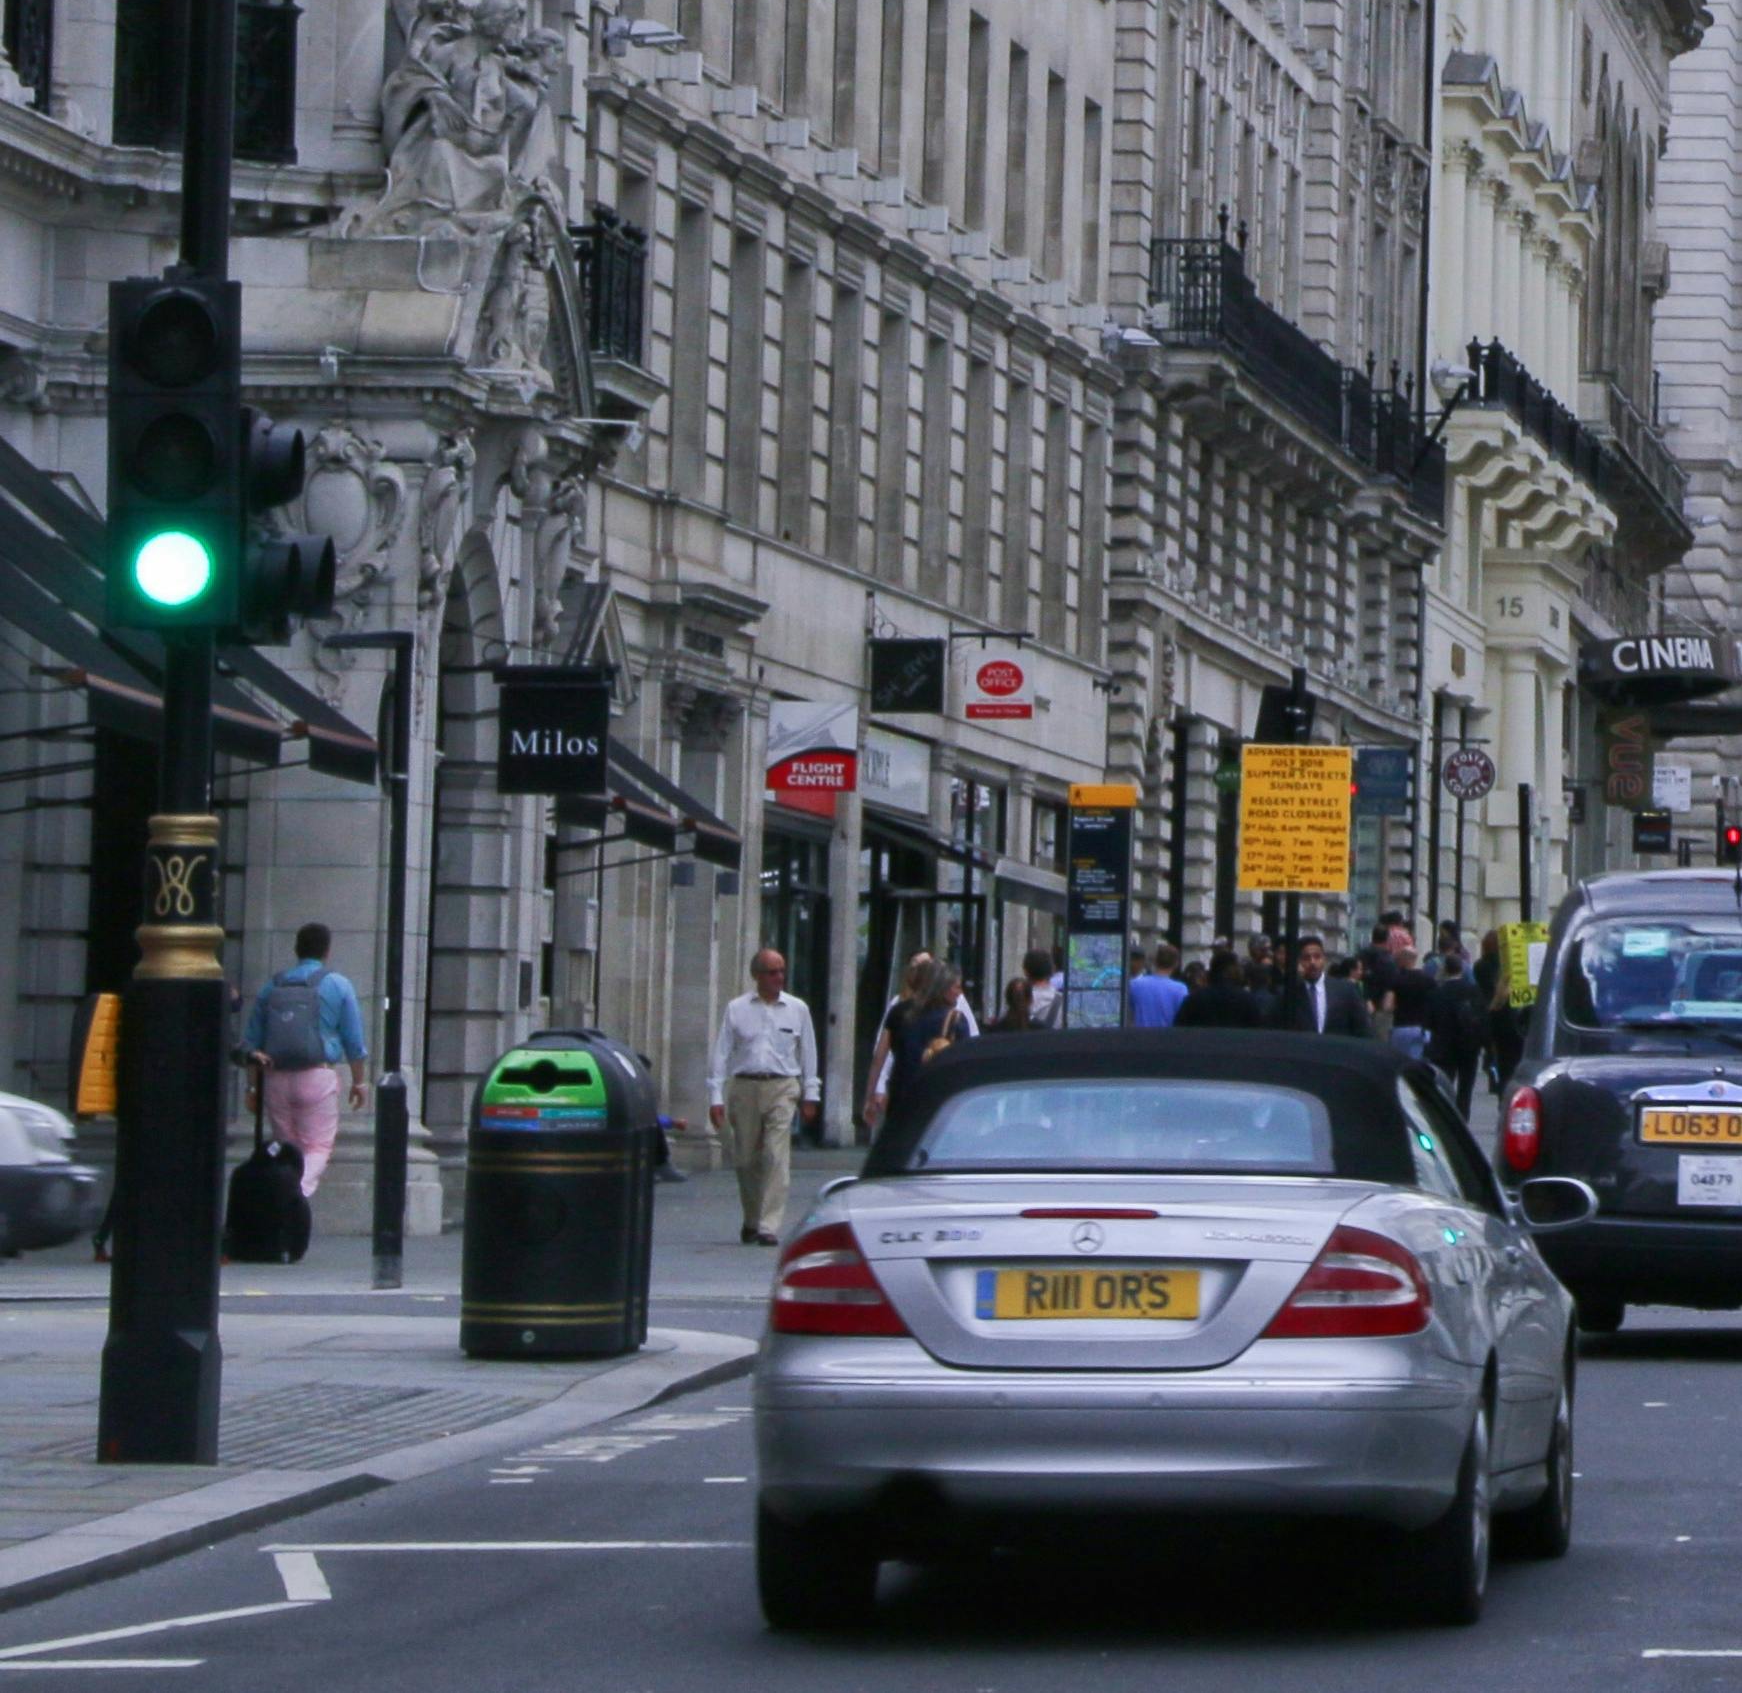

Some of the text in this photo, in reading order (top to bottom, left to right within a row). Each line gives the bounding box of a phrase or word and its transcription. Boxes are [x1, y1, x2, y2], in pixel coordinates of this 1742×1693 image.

[1497, 596, 1524, 618] 15
[1612, 636, 1715, 673] CINEMA
[986, 666, 1014, 677] POST
[980, 677, 1018, 688] OFFICE
[510, 729, 599, 756] Milos
[1453, 753, 1486, 767] COSTA
[792, 762, 845, 775] FLIGHT
[787, 774, 845, 787] CENTRE
[1270, 781, 1322, 791] SUNDAYS
[1449, 777, 1489, 796] COFFEE
[1251, 797, 1339, 806] REGENT STREET
[1248, 810, 1342, 820] ROAD CLOSURES
